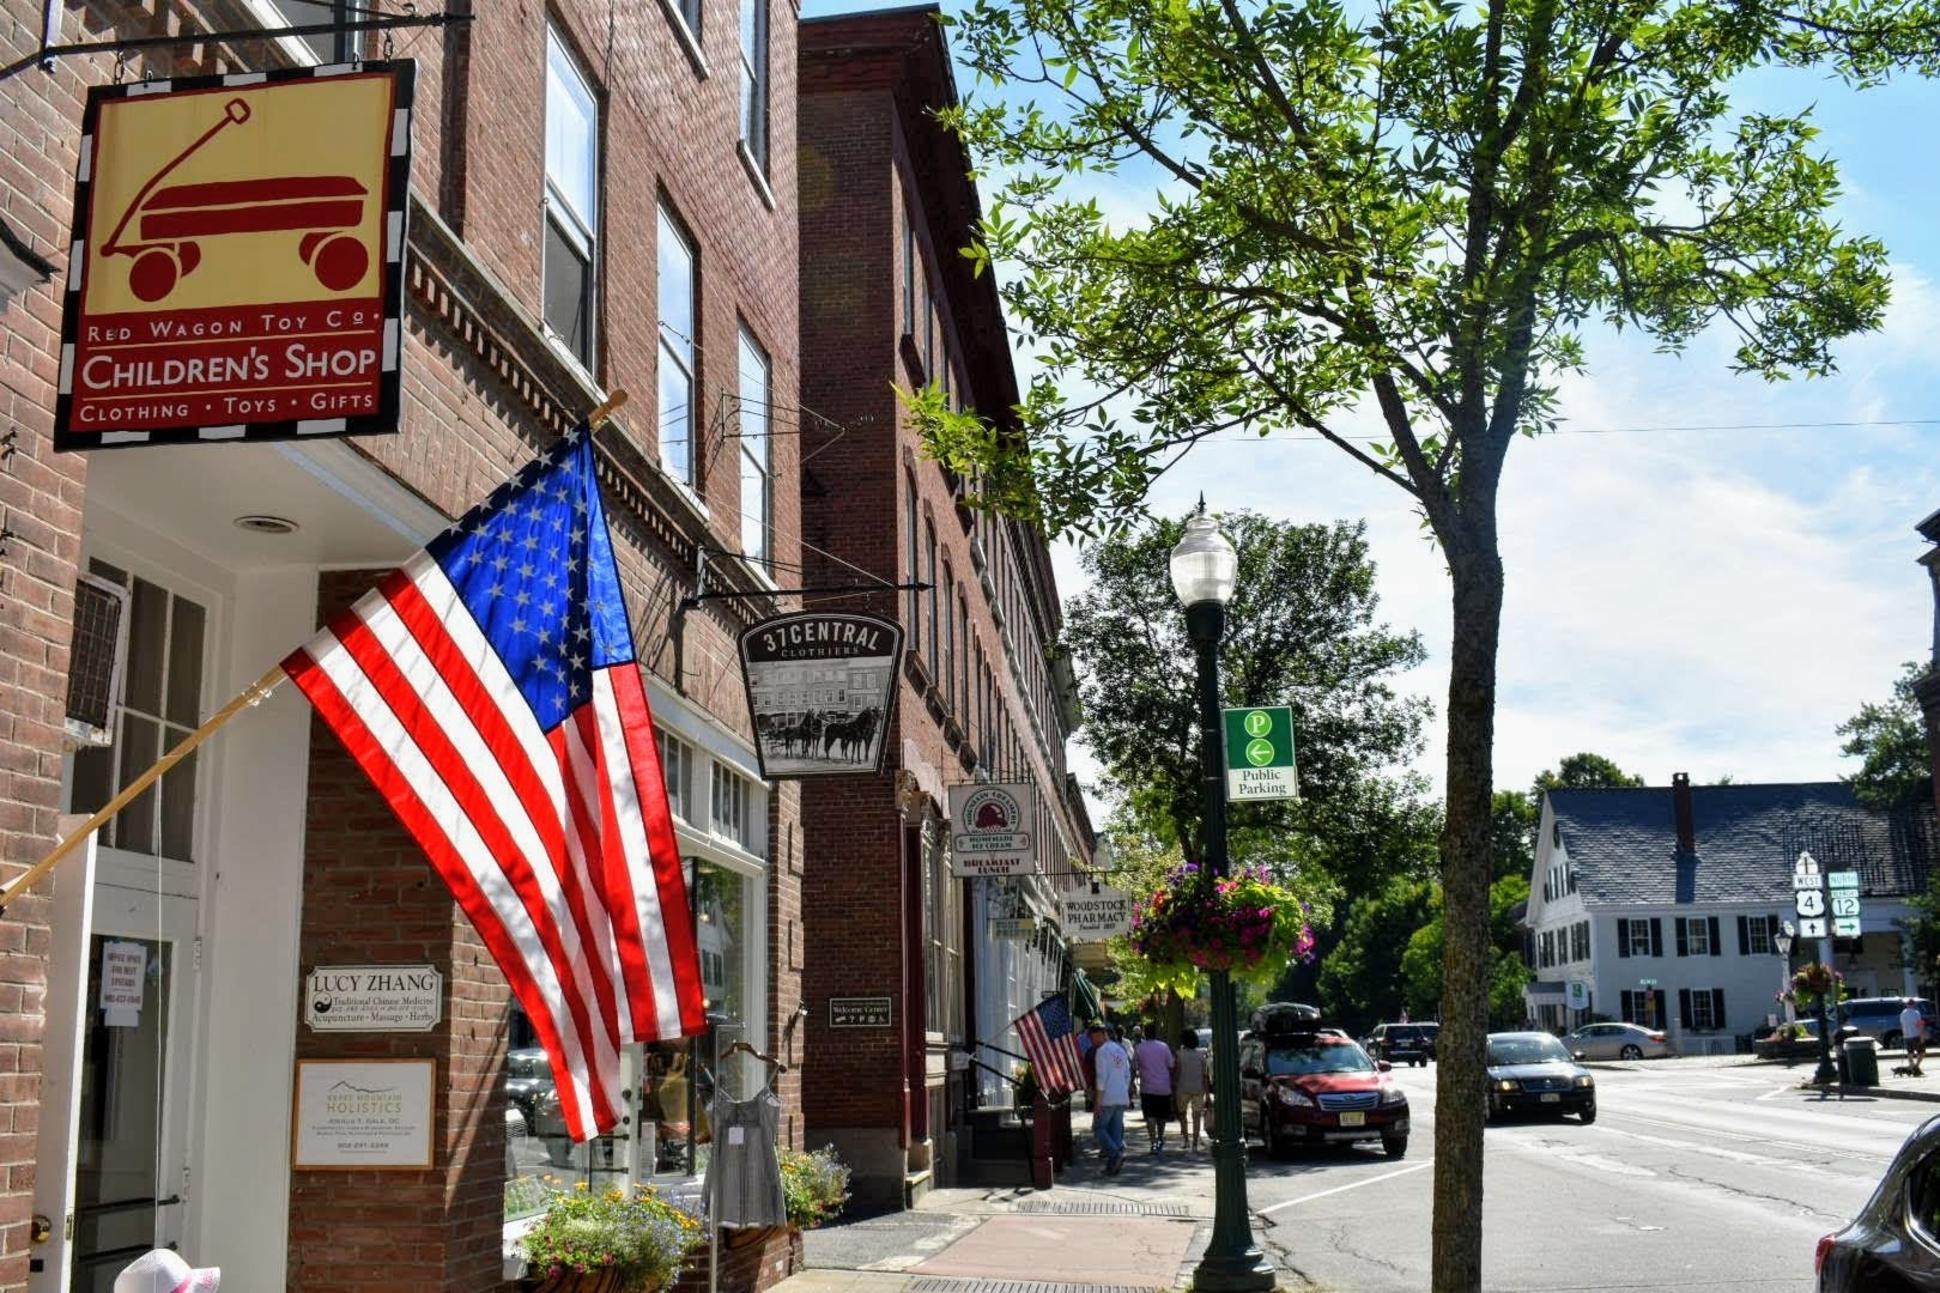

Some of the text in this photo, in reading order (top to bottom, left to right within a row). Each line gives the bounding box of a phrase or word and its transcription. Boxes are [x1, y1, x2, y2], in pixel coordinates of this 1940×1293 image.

[88, 326, 131, 342] RED
[150, 320, 243, 338] WAGON
[261, 314, 307, 331] TOY
[82, 343, 376, 390] CHILDREN'S SHOP
[80, 392, 373, 422] CLOTHING TOYS GIFTS
[781, 646, 861, 657] CLOTHIERS
[1250, 715, 1266, 733] P
[1243, 769, 1281, 781] Public
[1238, 783, 1287, 795] Parking
[978, 866, 1010, 874] LUNCH
[1797, 877, 1819, 885] WEST
[1066, 900, 1127, 912] WOODSTOCK
[1804, 896, 1814, 910] 4
[1836, 899, 1856, 914] 12
[1067, 912, 1127, 924] PHARMACY
[314, 974, 434, 992] LUCY ZHANG
[334, 996, 433, 1005] Traditional Chinese Medicine
[312, 1011, 433, 1023] Acupuncture Massage Herbs
[326, 1102, 402, 1113] HOLISTICS
